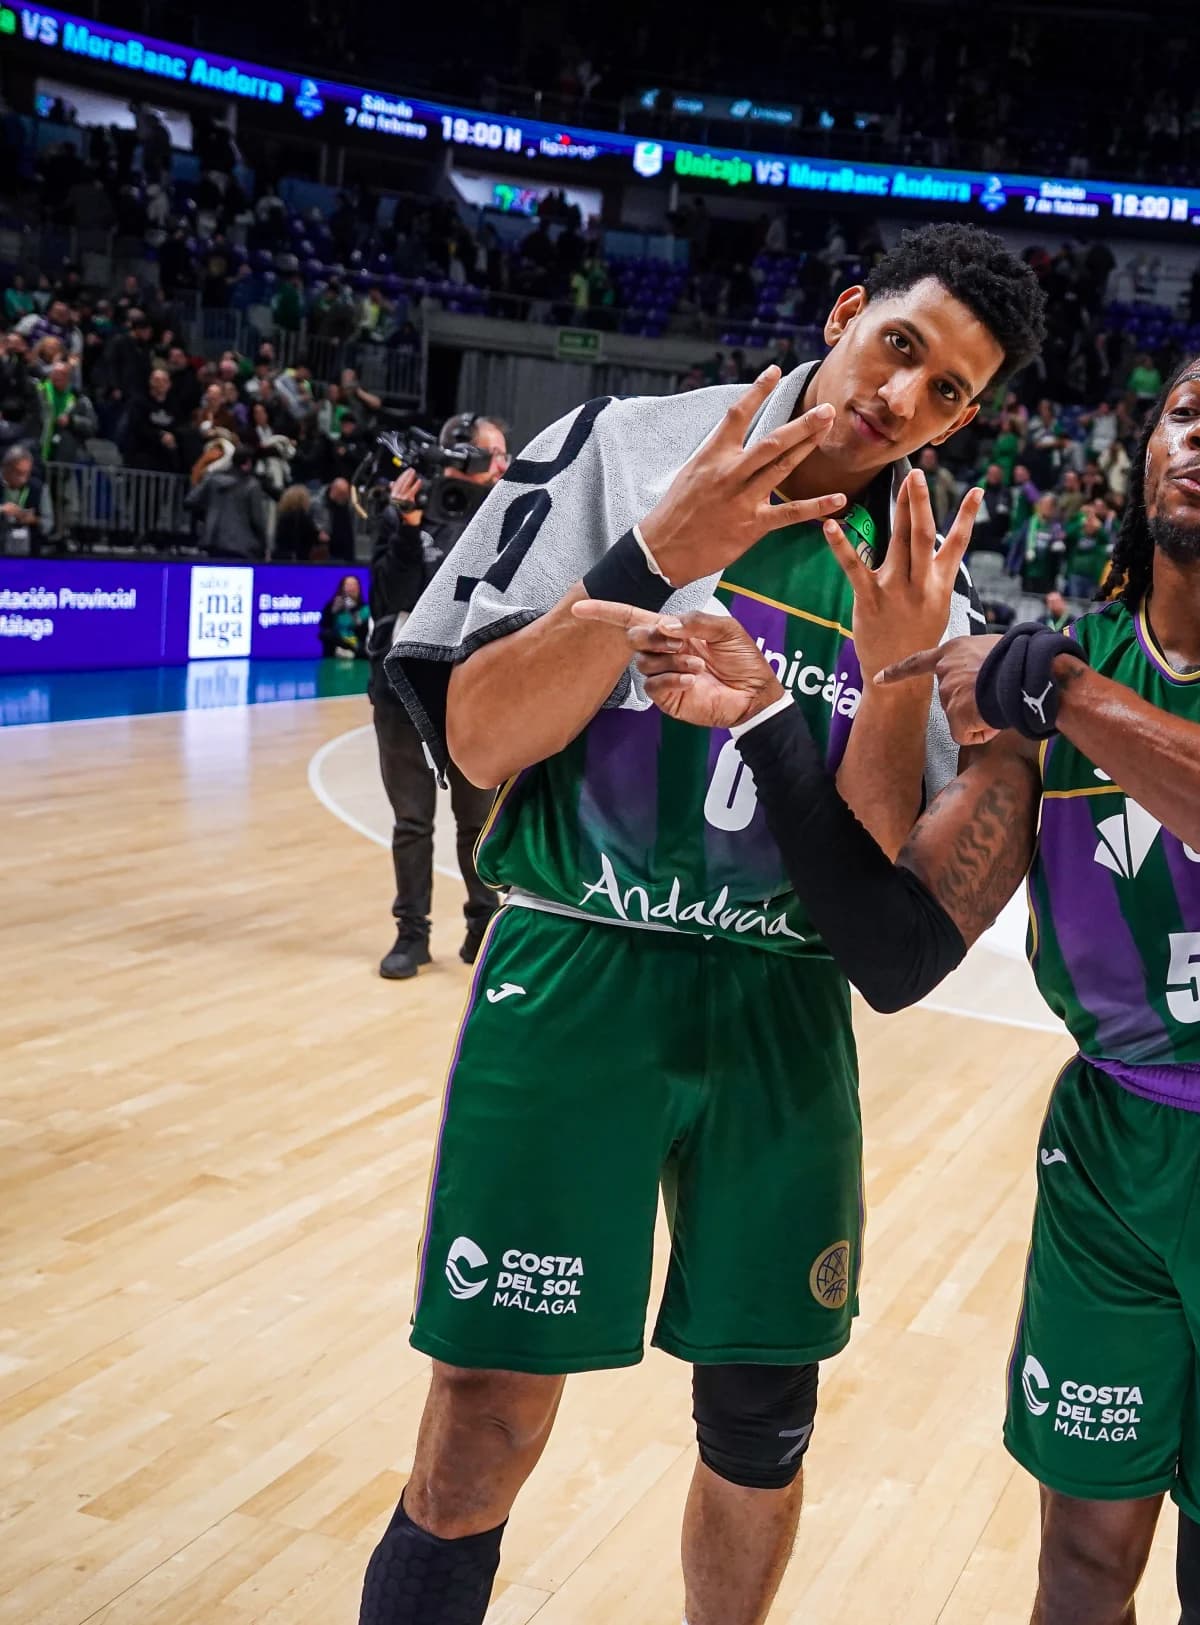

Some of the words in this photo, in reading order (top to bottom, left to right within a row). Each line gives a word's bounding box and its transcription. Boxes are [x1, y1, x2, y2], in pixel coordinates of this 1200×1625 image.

[21, 9, 58, 46] VS
[63, 21, 188, 81] MoraBanc
[190, 56, 284, 103] Andorra
[344, 106, 357, 126] 7
[441, 115, 503, 149] 19:00
[504, 128, 522, 154] H
[675, 149, 752, 187] Unicaja
[755, 158, 786, 187] VS
[787, 163, 888, 196] MoraBanc
[890, 172, 971, 203] Andorra
[1024, 195, 1036, 213] 7
[1170, 197, 1189, 222] H
[0, 586, 58, 610] tación
[59, 587, 136, 610] Provincial
[756, 636, 862, 719] nicaja
[501, 1249, 584, 1277] COSTA
[496, 1271, 539, 1295] DEL
[542, 1278, 582, 1297] SOL
[492, 1290, 578, 1315] MÁLAGA
[1060, 1380, 1144, 1406] COSTA
[1056, 1400, 1097, 1424] DEL
[1101, 1407, 1141, 1424] SOL
[1053, 1418, 1138, 1442] MÁLAGA
